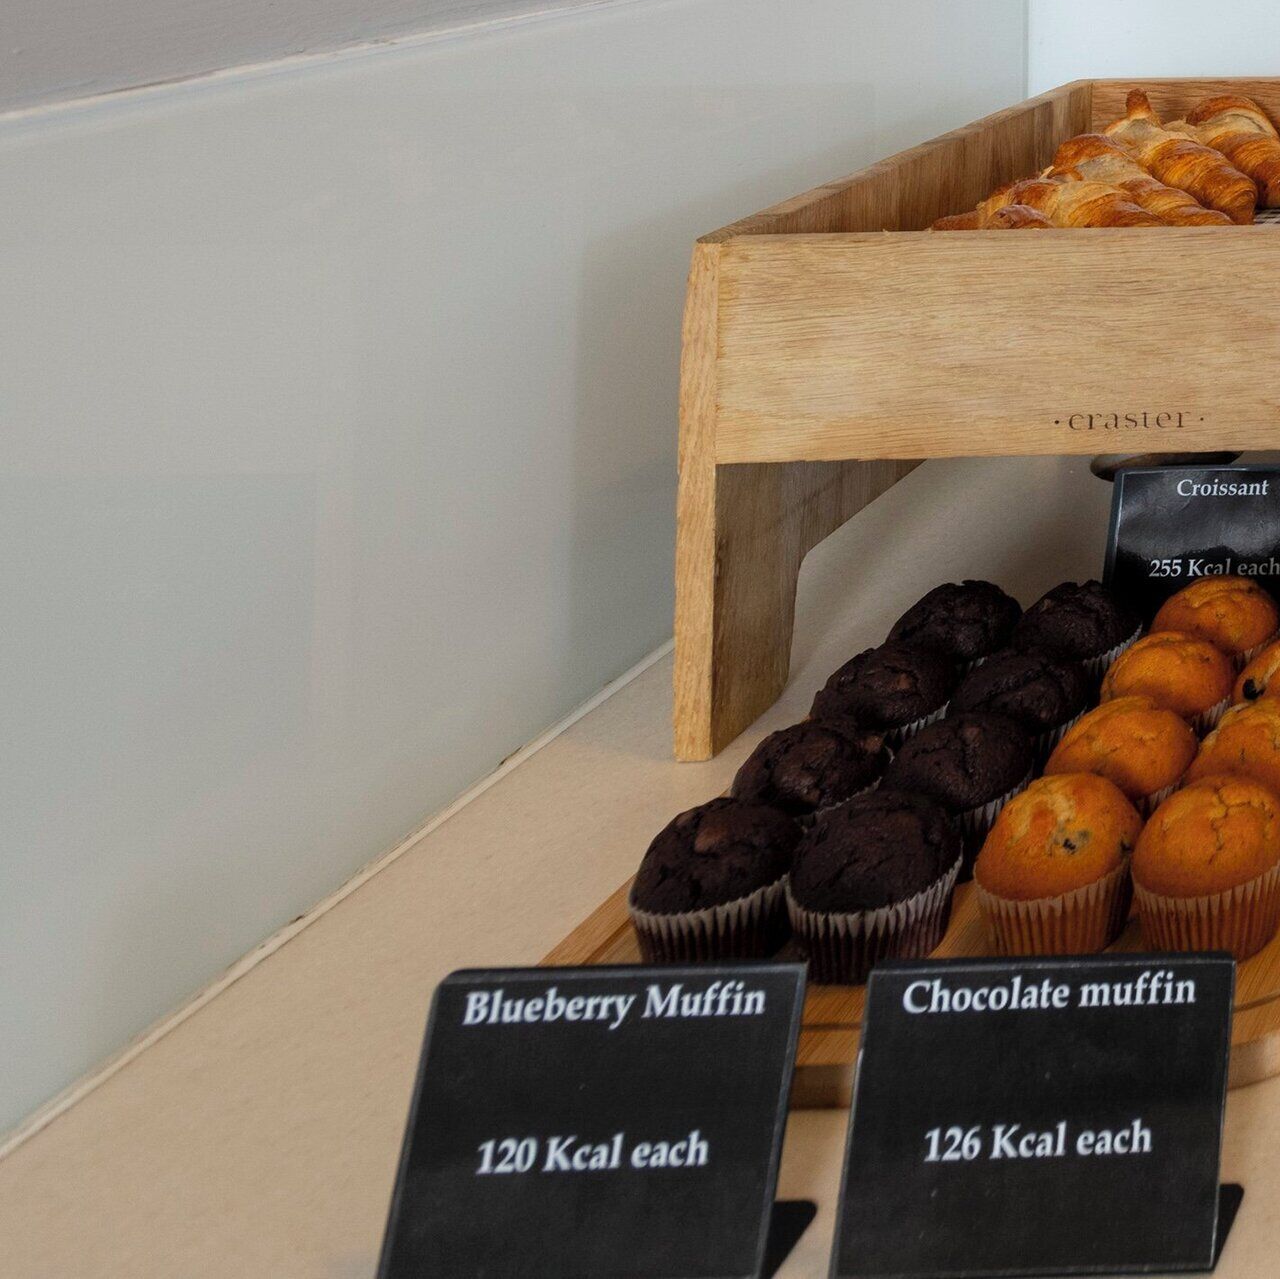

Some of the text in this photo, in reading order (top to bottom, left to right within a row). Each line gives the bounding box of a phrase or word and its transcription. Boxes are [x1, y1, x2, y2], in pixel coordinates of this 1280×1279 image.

[1068, 411, 1191, 431] craster
[1176, 478, 1269, 497] Croissant
[1149, 556, 1280, 577] 255 Kcal each
[463, 980, 766, 1029] Blueberry Muffin
[902, 970, 1196, 1014] Chocolate muffin
[476, 1130, 709, 1174] 120 Kcal each
[924, 1118, 1151, 1162] 126 Kcal each
